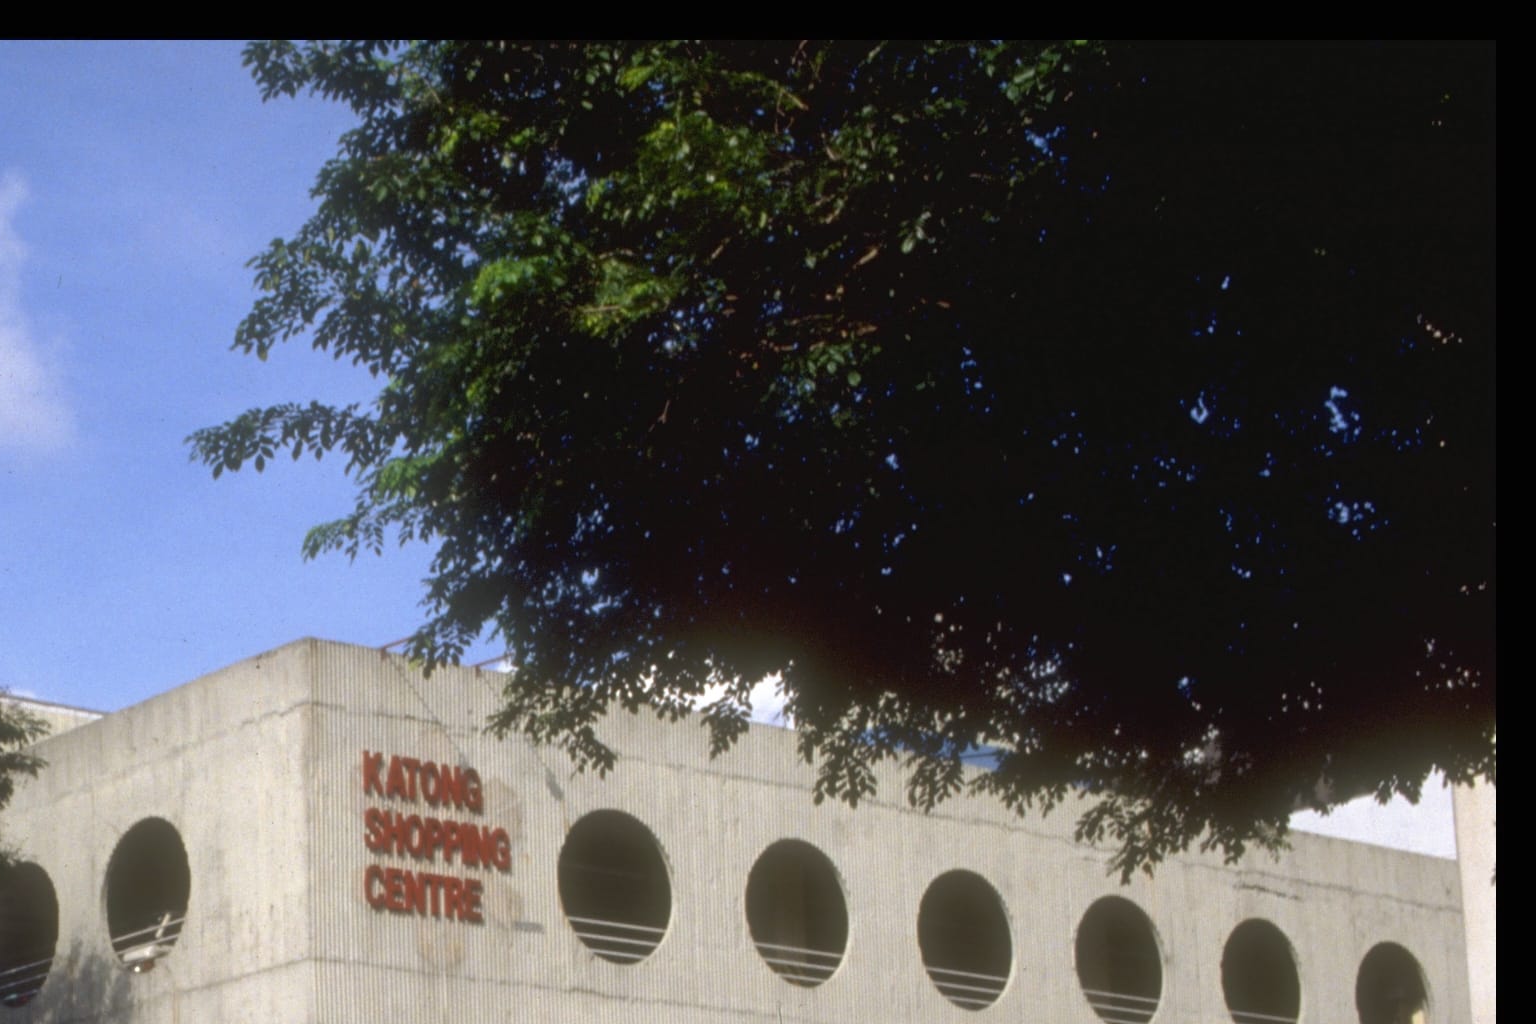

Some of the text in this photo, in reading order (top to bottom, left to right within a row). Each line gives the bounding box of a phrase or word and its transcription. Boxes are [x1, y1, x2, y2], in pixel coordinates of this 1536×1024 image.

[363, 750, 483, 816] KATONG
[364, 807, 512, 875] SHOPPING
[364, 864, 484, 924] CENTRE
